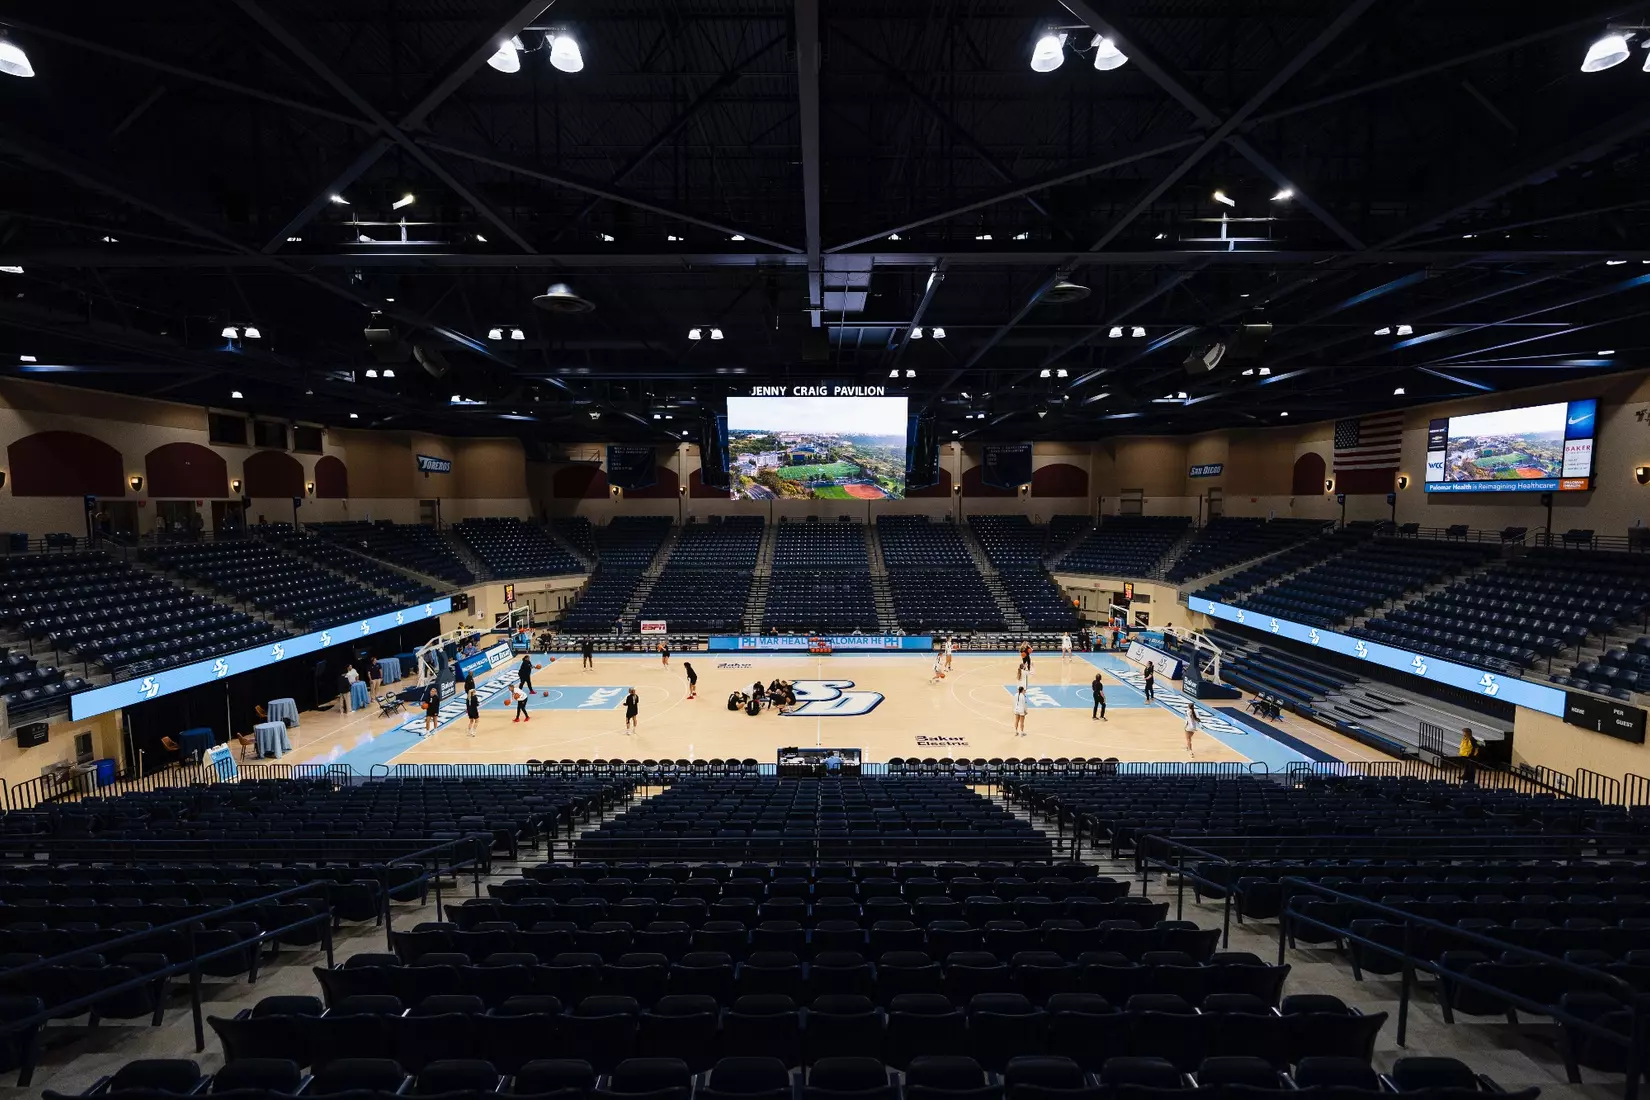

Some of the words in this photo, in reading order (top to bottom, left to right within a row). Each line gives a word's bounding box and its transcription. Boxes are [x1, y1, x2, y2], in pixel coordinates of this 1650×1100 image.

[751, 386, 786, 396] JENNY
[793, 386, 827, 396] CRAIG
[834, 386, 884, 396] PAVILION
[418, 456, 450, 471] TOREROS
[1191, 467, 1203, 475] SAN
[1479, 482, 1516, 491] Reimagining
[642, 623, 666, 631] ESPN
[1613, 708, 1624, 716] PER
[1615, 719, 1634, 728] GUEST
